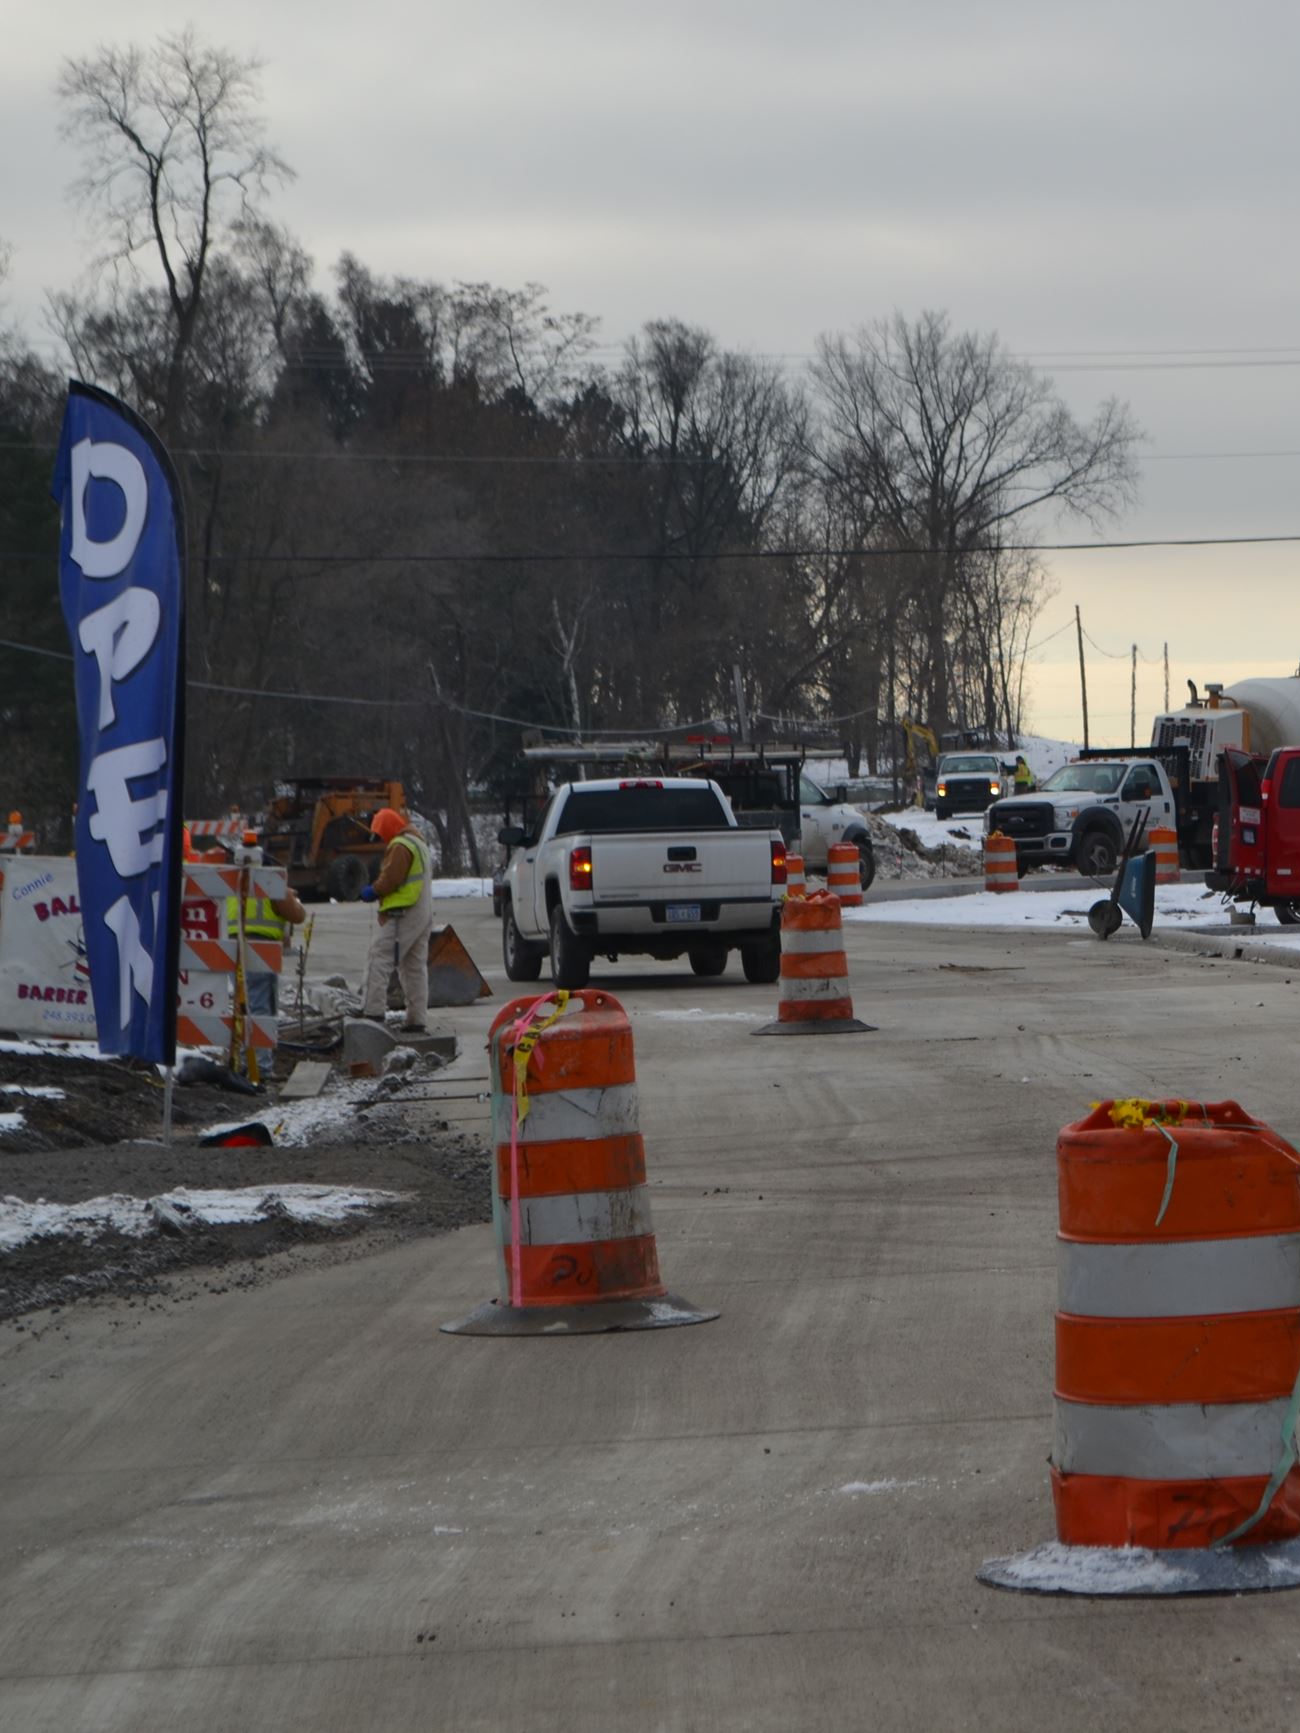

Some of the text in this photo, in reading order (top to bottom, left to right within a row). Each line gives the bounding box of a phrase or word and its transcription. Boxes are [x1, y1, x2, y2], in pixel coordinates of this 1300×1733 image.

[70, 437, 167, 1031] OPEN
[663, 863, 702, 873] GMC
[12, 872, 54, 901] Connie
[18, 983, 88, 1005] BARBER
